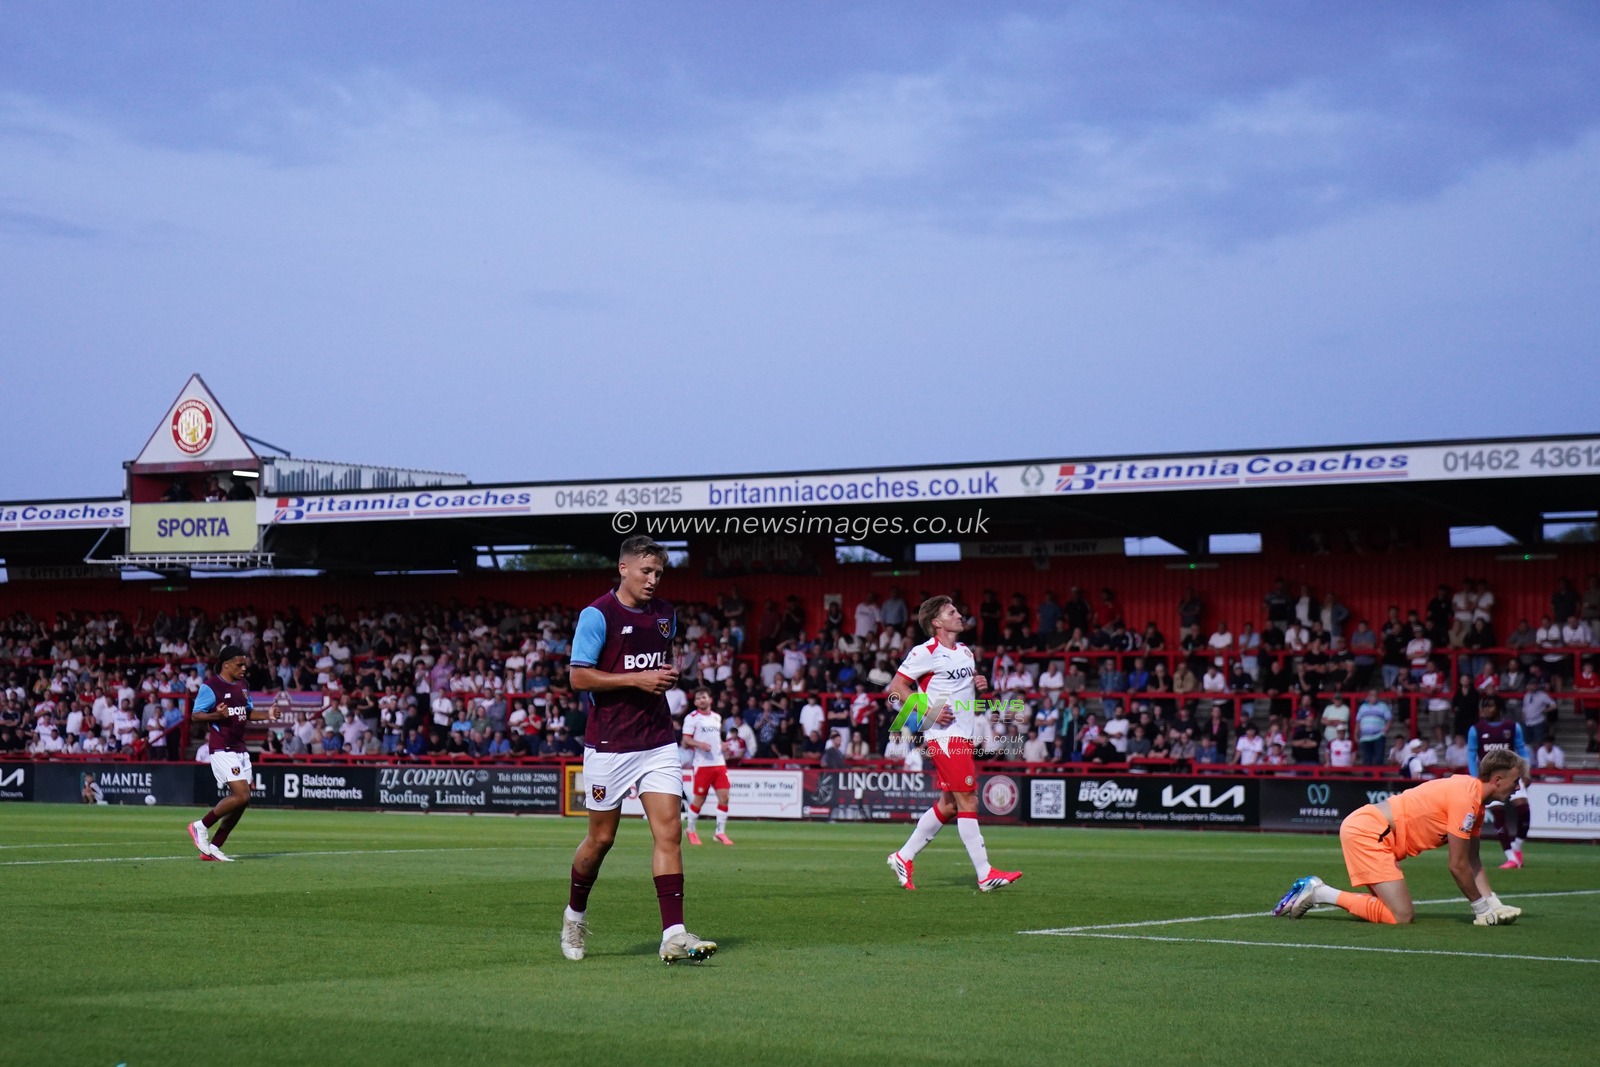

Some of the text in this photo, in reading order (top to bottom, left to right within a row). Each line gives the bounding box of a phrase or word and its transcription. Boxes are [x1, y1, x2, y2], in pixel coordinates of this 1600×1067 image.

[1442, 449, 1520, 472] 01462
[1055, 453, 1408, 492] Britannia Coaches
[555, 486, 682, 508] 01462 436125
[708, 471, 998, 506] britanniacoaches.co.uk
[22, 504, 124, 520] Coaches
[275, 490, 531, 522] Britannia Coaches
[157, 517, 230, 538] SPORTA
[1054, 542, 1098, 553] HENRY
[100, 772, 152, 787] MANTLE
[302, 774, 346, 787] Balstone
[403, 768, 476, 786] COPPING
[838, 772, 925, 792] LINCOLNS
[1080, 781, 1100, 789] KEN
[302, 786, 362, 800] Investments
[380, 789, 486, 808] Roofing Limited
[1078, 788, 1138, 802] BROWN
[1548, 792, 1578, 806] One
[1169, 812, 1208, 822] Supporters
[1209, 812, 1245, 822] Discounts
